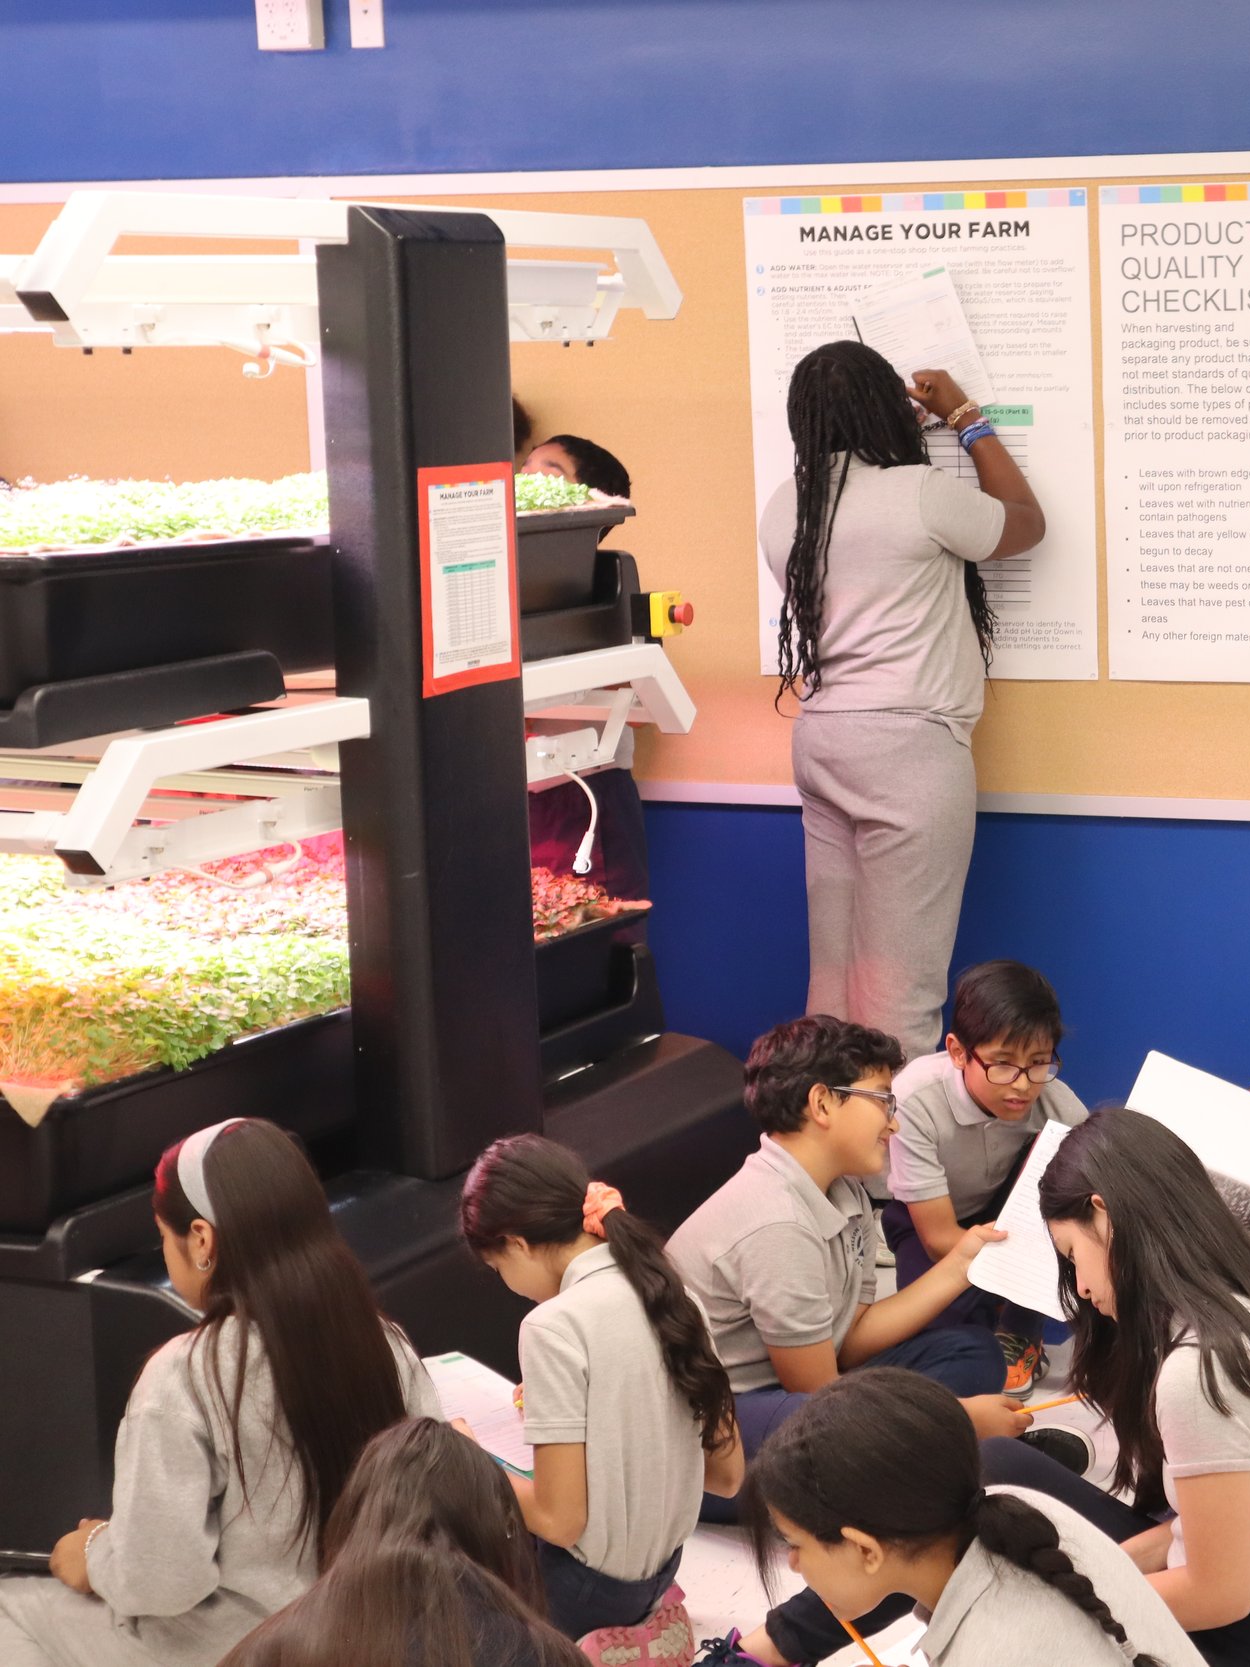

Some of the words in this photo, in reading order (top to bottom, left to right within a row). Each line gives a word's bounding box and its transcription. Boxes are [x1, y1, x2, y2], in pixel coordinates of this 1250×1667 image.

[800, 224, 892, 242] MANAGE
[900, 223, 960, 240] YOUR
[968, 221, 1030, 238] FARM
[1120, 255, 1243, 281] QUALITY
[1121, 322, 1152, 333] When
[1155, 321, 1211, 335] harvesting
[1214, 321, 1235, 331] and
[1121, 337, 1176, 351] packaging
[1225, 336, 1240, 347] be
[1121, 353, 1168, 366] separate
[1171, 355, 1191, 366] any
[1193, 352, 1234, 366] product
[1122, 369, 1139, 378] not
[1141, 369, 1169, 378] meet
[1171, 368, 1225, 378] standards
[1227, 367, 1238, 378] of
[1187, 383, 1208, 393] The
[1210, 382, 1242, 393] below
[1123, 398, 1167, 409] includes
[1169, 401, 1199, 409] some
[1202, 399, 1231, 412] types
[1234, 398, 1245, 408] of
[1123, 414, 1144, 424] that
[1147, 413, 1182, 424] should
[1184, 413, 1198, 424] be
[1201, 413, 1248, 424] removed
[1124, 429, 1148, 442] prior
[1151, 429, 1161, 439] to
[1164, 428, 1204, 442] product
[1138, 467, 1174, 477] Leaves
[1176, 467, 1196, 477] with
[1198, 467, 1228, 477] brown
[1138, 480, 1155, 490] wilt
[1157, 483, 1181, 493] upon
[1184, 480, 1242, 493] refrigeration
[440, 491, 462, 500] MANAGE
[464, 490, 478, 498] YOUR
[480, 488, 494, 496] FARM
[1139, 498, 1174, 508] Leaves
[1176, 499, 1194, 508] wet
[1196, 498, 1215, 508] with
[1139, 512, 1174, 521] contain
[1176, 511, 1227, 524] pathogens
[1139, 528, 1174, 539] Leaves
[1176, 528, 1195, 539] that
[1197, 531, 1214, 539] are
[1216, 529, 1247, 542] yellow
[1139, 545, 1170, 558] begun
[1172, 546, 1182, 555] to
[1184, 545, 1213, 559] decay
[1139, 562, 1175, 572] Leaves
[1177, 562, 1195, 573] that
[1198, 565, 1214, 573] are
[1216, 564, 1232, 573] not
[1140, 579, 1167, 589] these
[1169, 582, 1190, 593] may
[1192, 579, 1205, 590] be
[1207, 579, 1239, 590] weeds
[1140, 596, 1175, 607] Leaves
[1178, 596, 1196, 607] that
[1198, 597, 1222, 607] have
[1225, 598, 1246, 610] pest
[1141, 630, 1160, 643] Any
[1162, 630, 1187, 640] other
[1189, 630, 1222, 644] foreign
